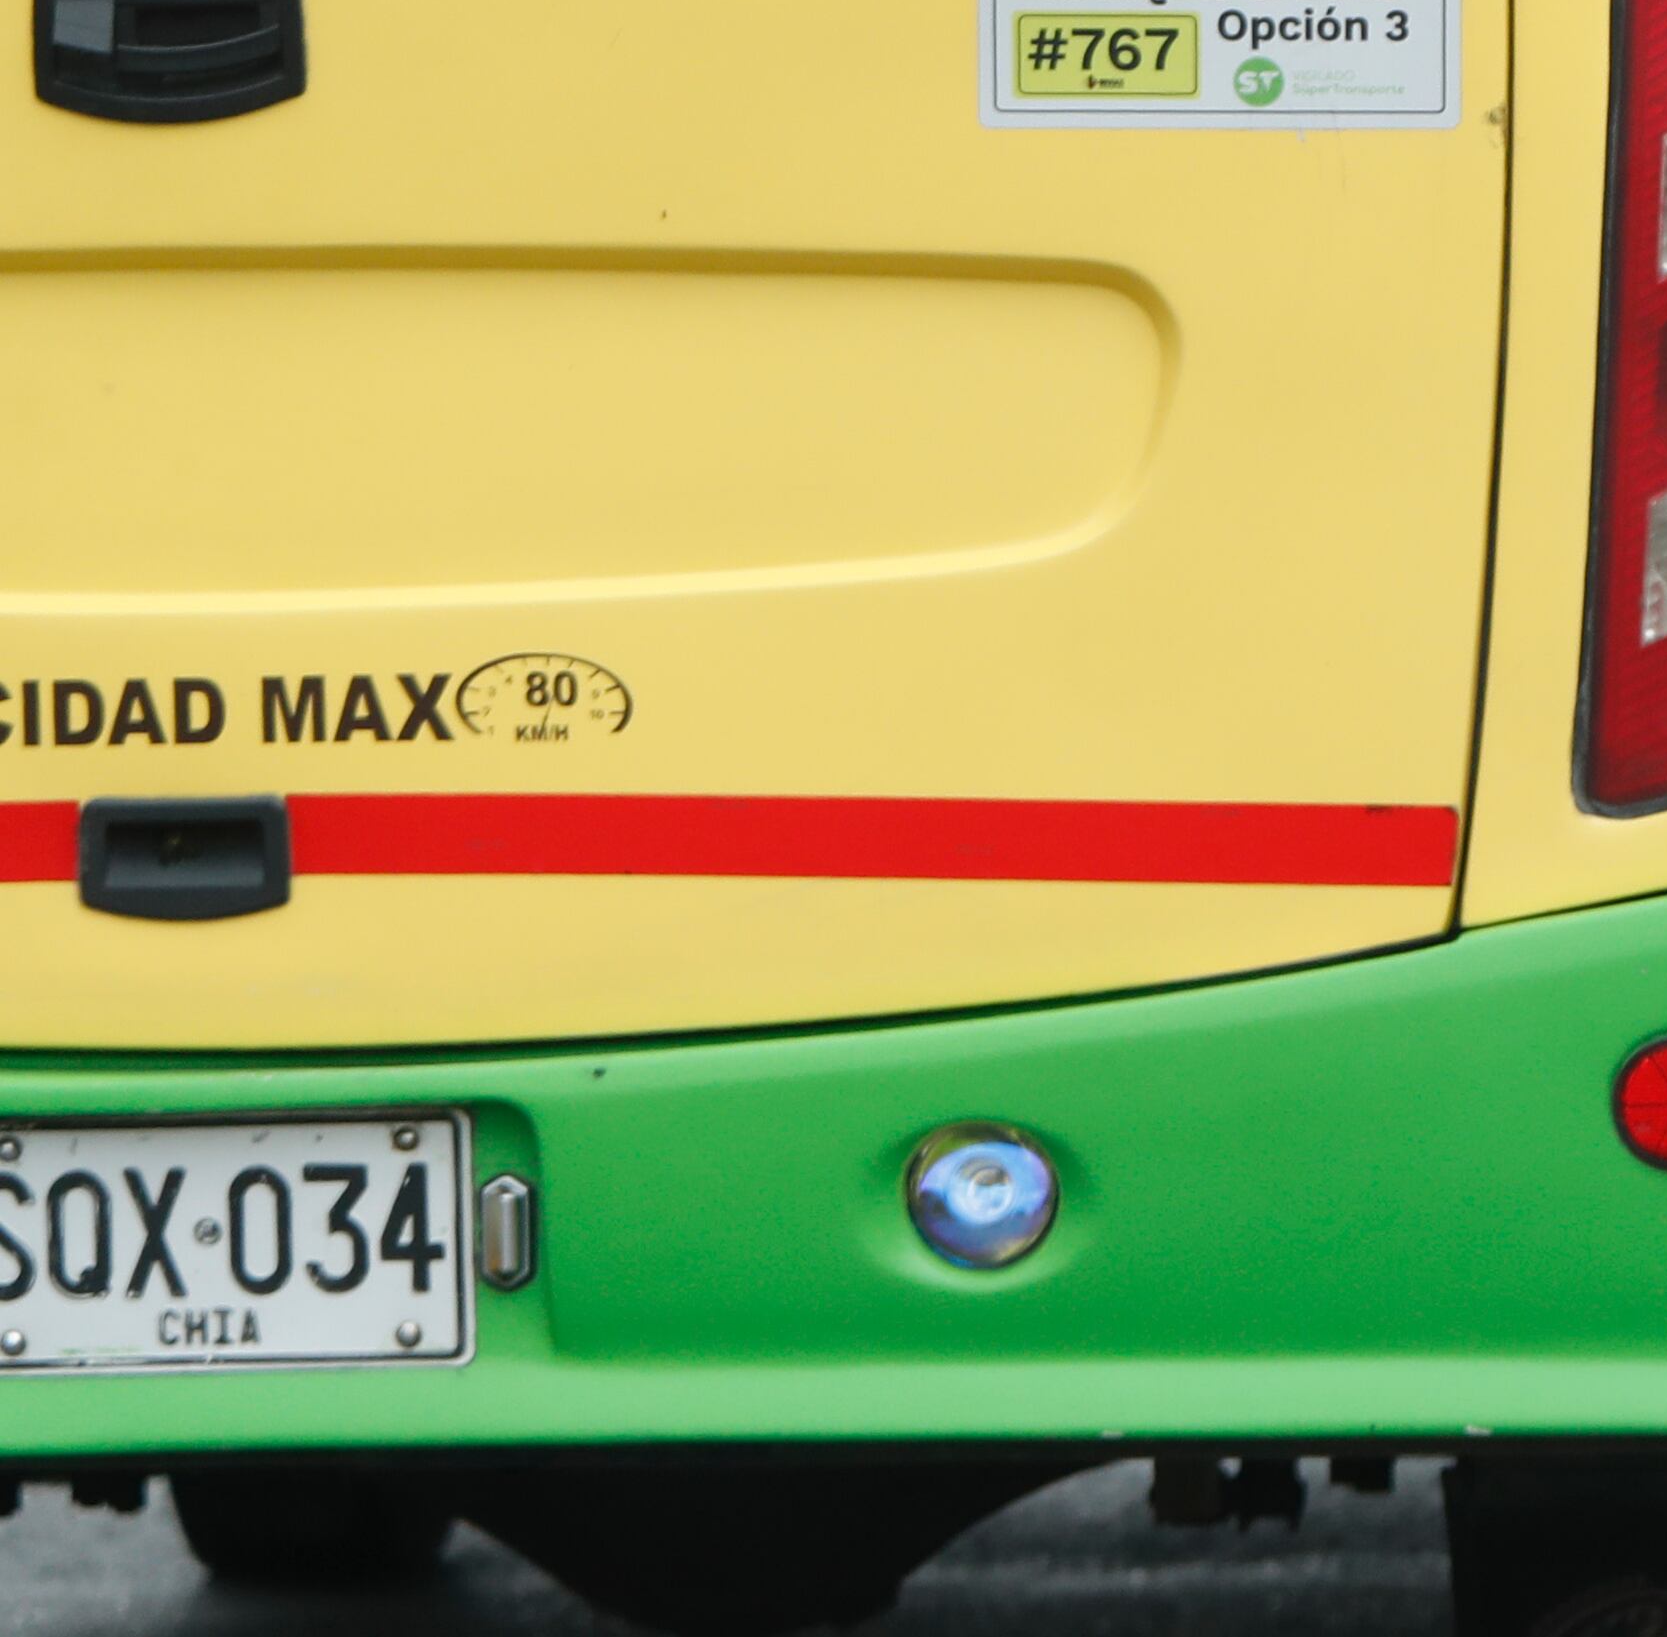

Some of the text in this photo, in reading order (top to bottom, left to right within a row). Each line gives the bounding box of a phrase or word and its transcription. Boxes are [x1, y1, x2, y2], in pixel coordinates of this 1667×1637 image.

[1027, 27, 1180, 72] #767
[1216, 7, 1409, 50] Opción 3
[0, 672, 455, 748] IDAD MAX
[525, 670, 578, 707] 80
[515, 725, 569, 742] KM/H
[0, 1162, 445, 1301] SQX 034
[157, 1307, 261, 1347] CHIA
